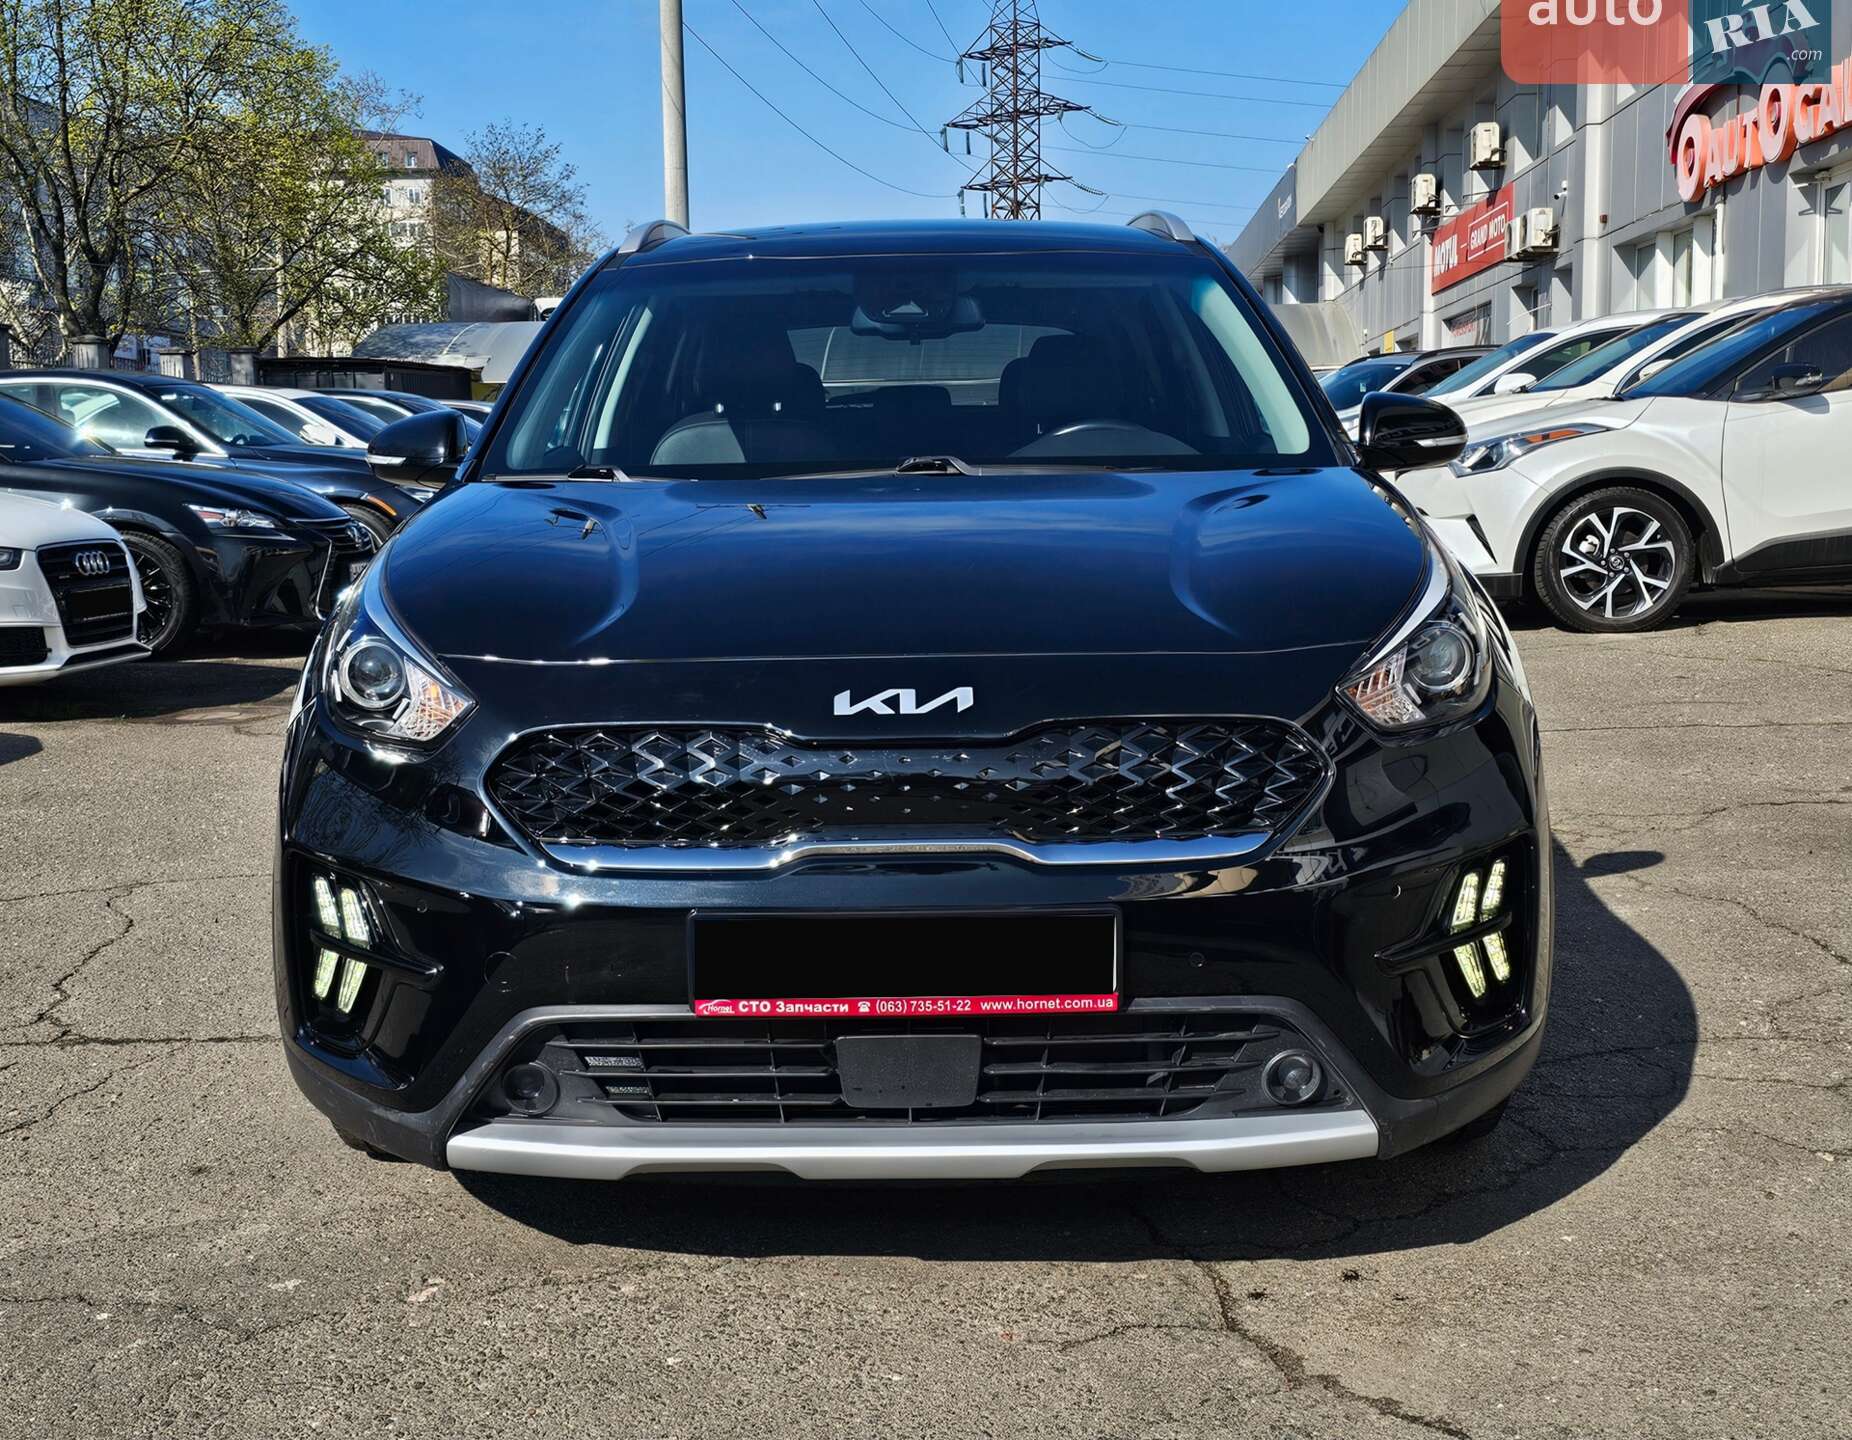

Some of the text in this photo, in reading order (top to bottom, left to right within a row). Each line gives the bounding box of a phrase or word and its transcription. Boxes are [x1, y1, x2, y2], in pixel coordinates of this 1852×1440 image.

[1433, 233, 1458, 278] MOTUL
[1488, 213, 1506, 241] MOTO
[833, 686, 974, 716] KIA
[738, 996, 1114, 1013] СТО Запчасти (063) 735-51-22 www.hornet.com.ua
